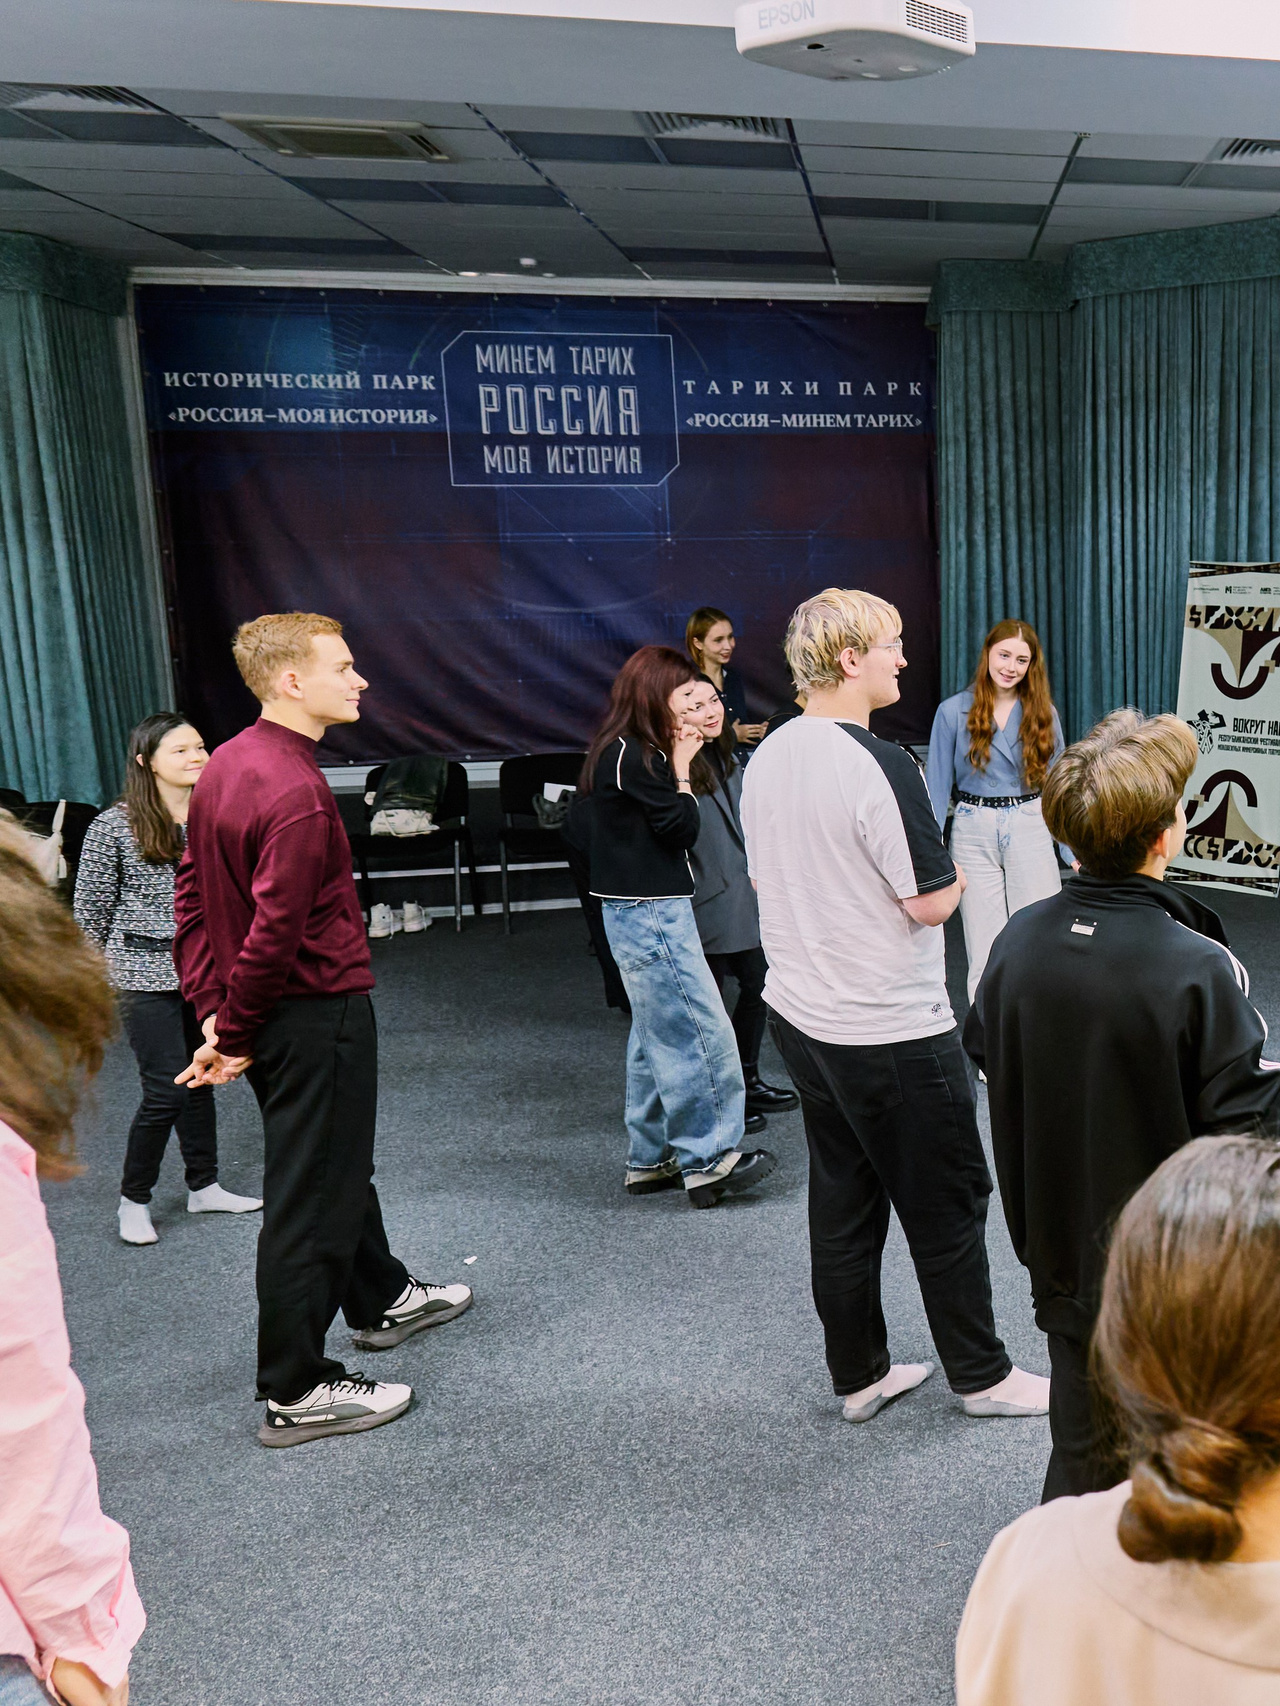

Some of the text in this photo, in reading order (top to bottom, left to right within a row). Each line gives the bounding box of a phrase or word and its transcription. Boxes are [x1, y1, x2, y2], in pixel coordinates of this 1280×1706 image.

[758, 0, 815, 29] EPSON
[475, 343, 636, 376] МИНЕМ ТАРИХ
[164, 370, 437, 390] ИСТОРИЧЕСКИЙ ПАРК
[683, 380, 922, 396] ТАРИХИ ПАРК
[479, 383, 640, 436] РОССИЯ
[483, 445, 642, 474] МОЯ ИСТОРИЯ
[1233, 717, 1266, 734] ВОКРУГ
